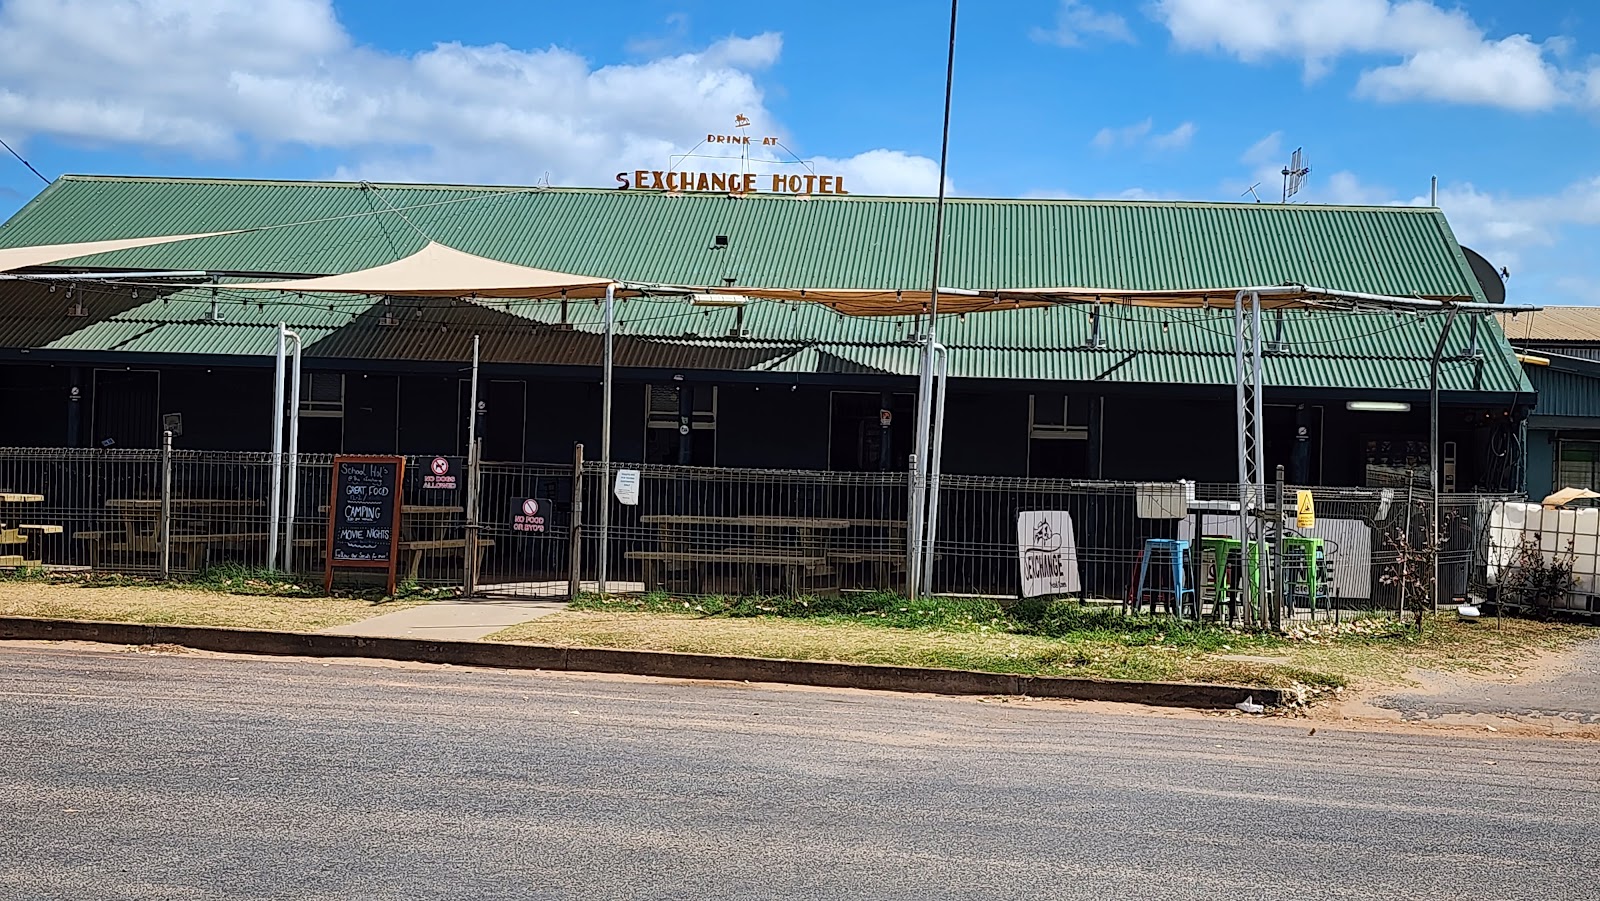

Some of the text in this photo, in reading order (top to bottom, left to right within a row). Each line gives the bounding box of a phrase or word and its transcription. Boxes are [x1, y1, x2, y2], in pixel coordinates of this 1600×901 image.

[706, 134, 779, 146] DRINK AT
[772, 173, 849, 195] HOTEL
[340, 463, 366, 476] School
[436, 475, 456, 483] DOGS
[345, 485, 389, 497] GREAT FOOD
[344, 505, 381, 519] CAMPING
[514, 515, 545, 525] NO FOOD
[513, 524, 523, 532] OR
[340, 528, 390, 541] MOVIE NIGHTS
